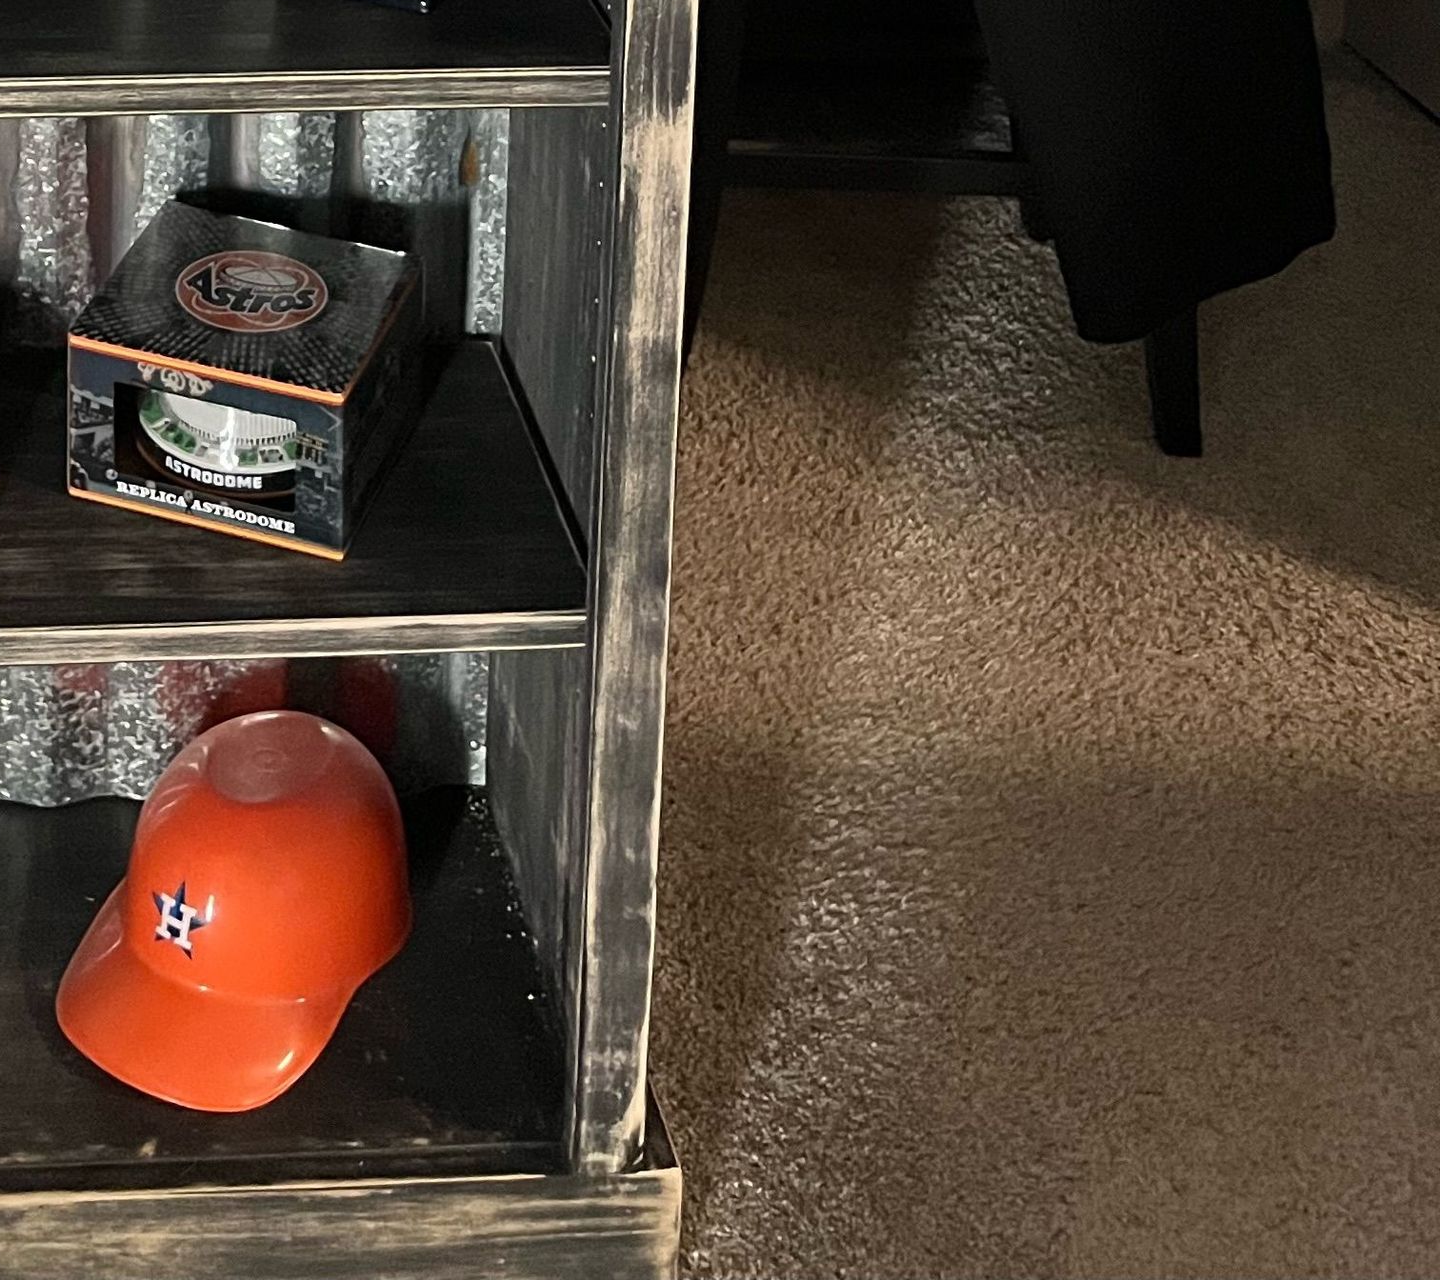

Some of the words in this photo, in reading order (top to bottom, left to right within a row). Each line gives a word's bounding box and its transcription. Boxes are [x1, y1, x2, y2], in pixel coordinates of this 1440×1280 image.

[184, 261, 319, 313] Astros
[165, 455, 263, 490] ASTRODOME
[116, 481, 188, 508] REPLICA
[190, 499, 296, 534] ASTRODOME
[156, 893, 199, 951] H
